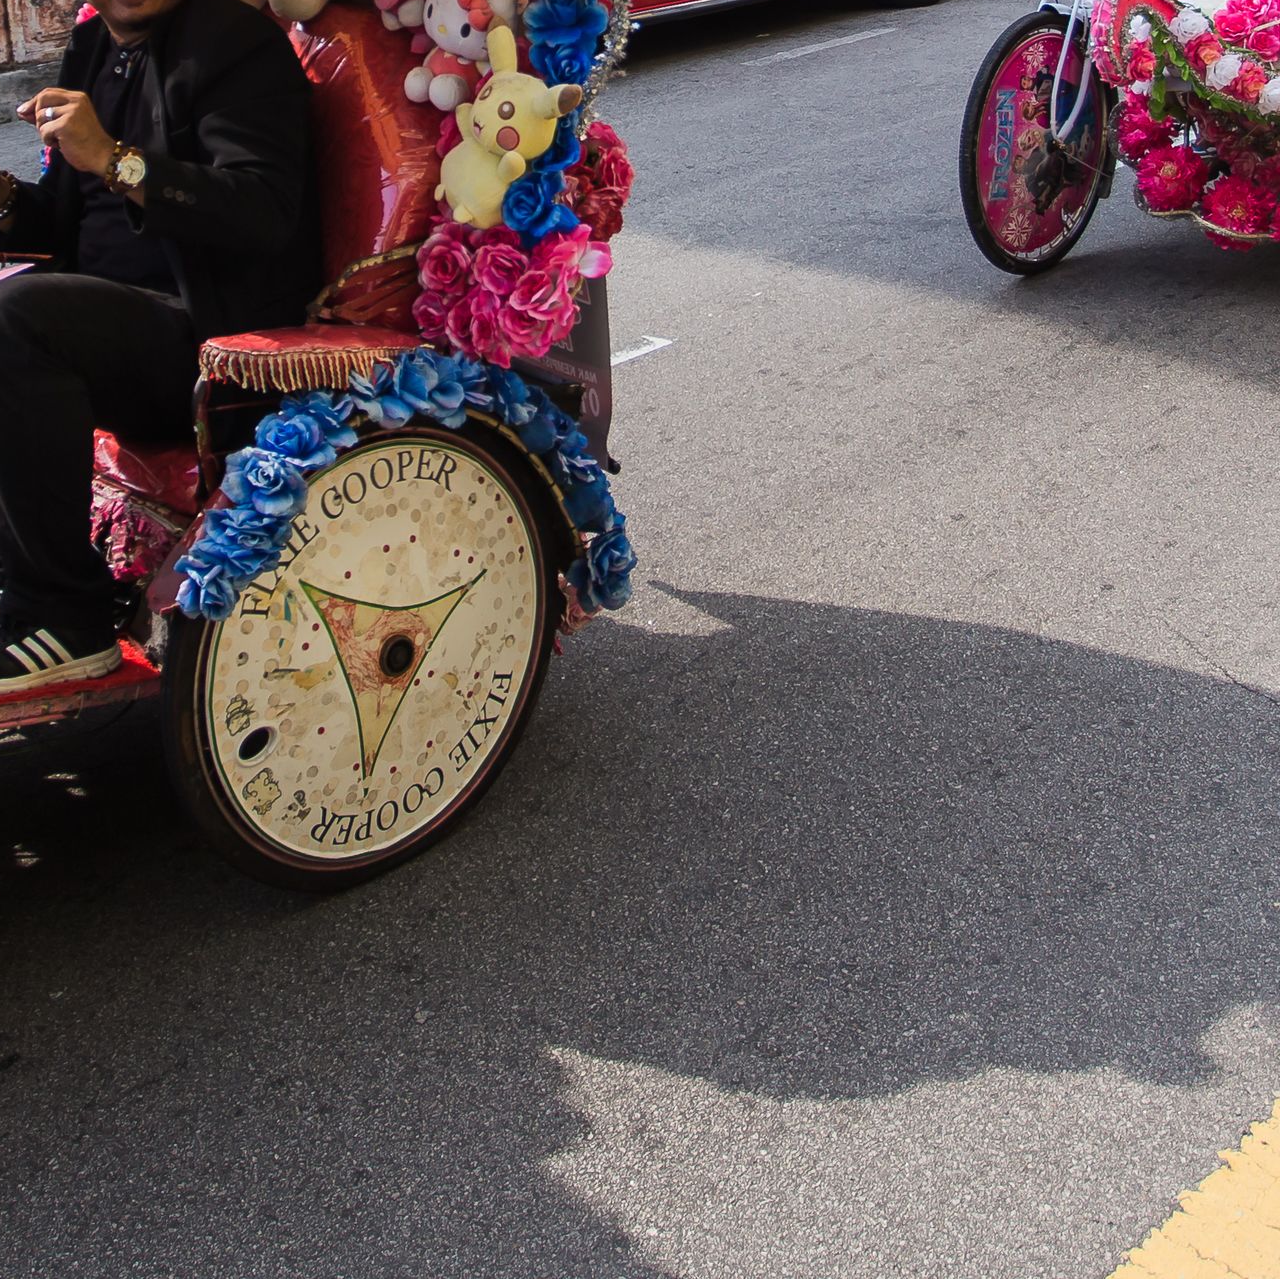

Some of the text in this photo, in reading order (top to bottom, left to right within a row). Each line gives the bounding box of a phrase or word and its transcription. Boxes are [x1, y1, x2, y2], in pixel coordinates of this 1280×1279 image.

[989, 88, 1017, 201] FROZEN
[319, 447, 459, 521] COOPER
[310, 668, 514, 846] FIXIE COOPER
